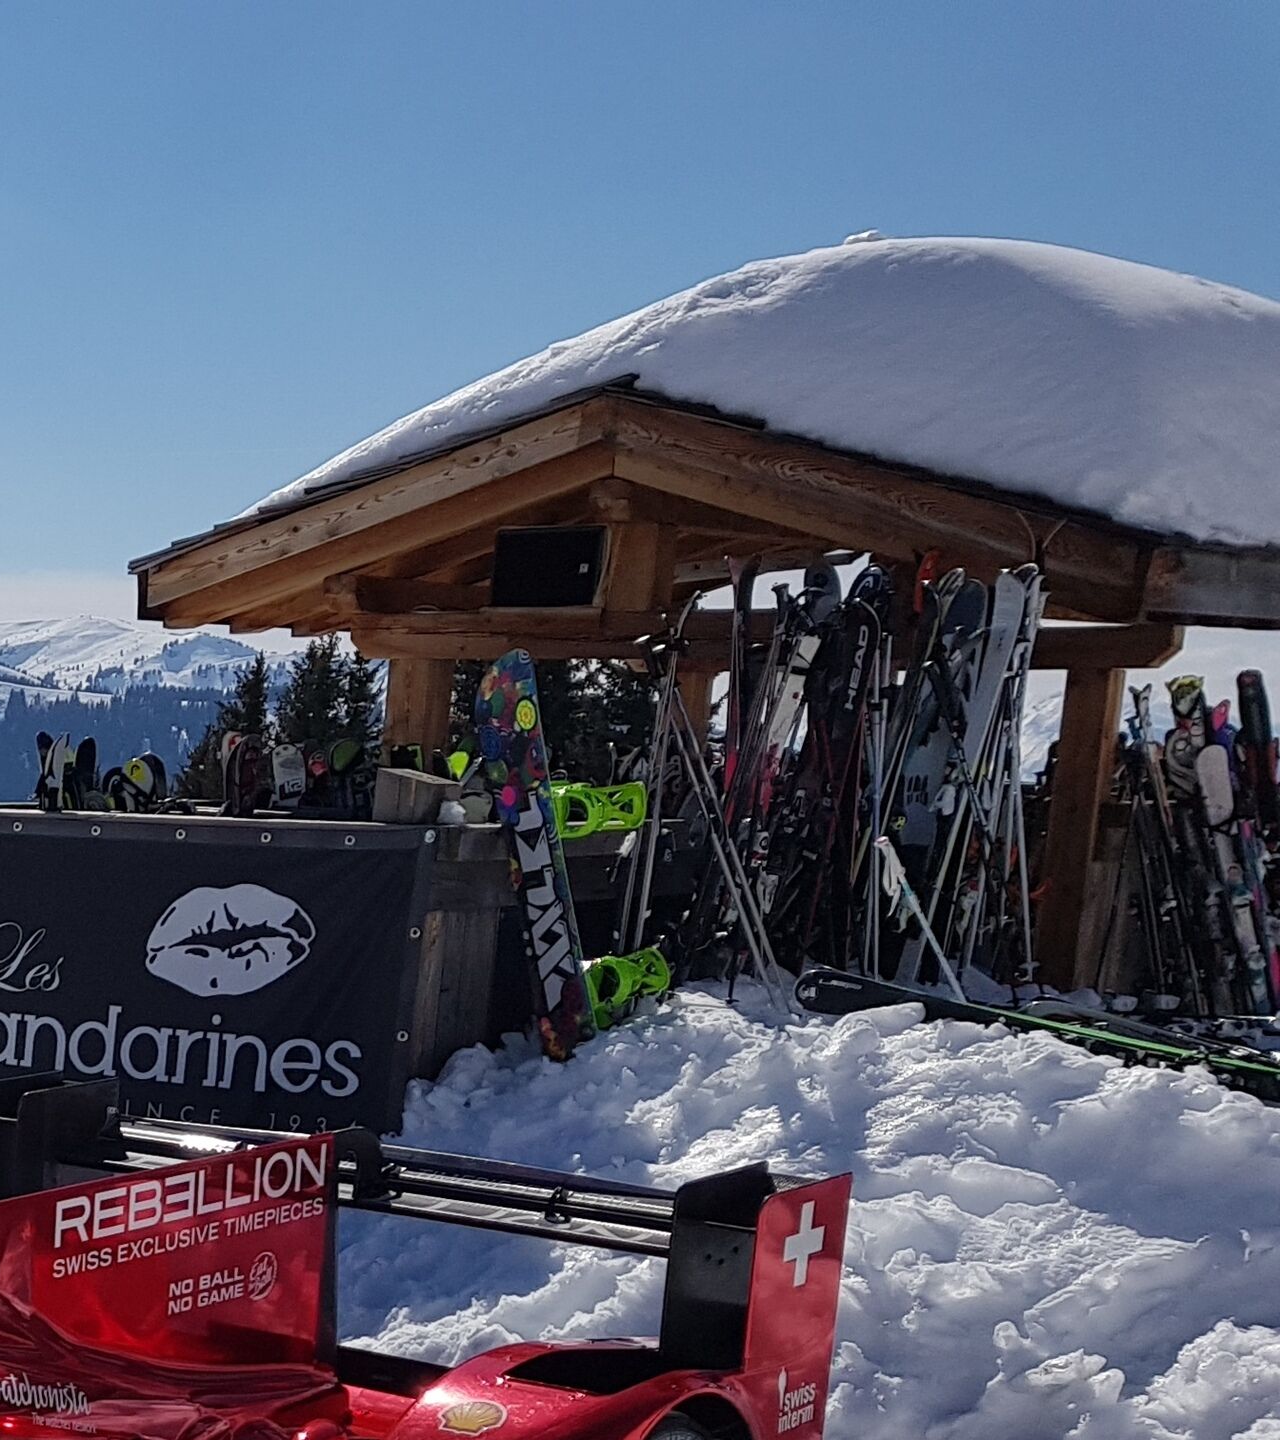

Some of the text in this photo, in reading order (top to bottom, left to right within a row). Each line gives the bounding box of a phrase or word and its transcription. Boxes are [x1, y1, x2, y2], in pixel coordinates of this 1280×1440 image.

[844, 624, 869, 711] HEAD
[123, 1099, 221, 1125] INCE
[53, 1142, 328, 1249] REBELLION
[52, 1197, 325, 1279] SWISS EXCLUSIVE TIMEPIECES
[168, 1278, 194, 1298] NO
[199, 1266, 245, 1291] BALL
[167, 1296, 193, 1316] NO
[197, 1282, 245, 1308] GAME
[784, 1382, 817, 1413] swiss
[777, 1402, 815, 1434] interim
